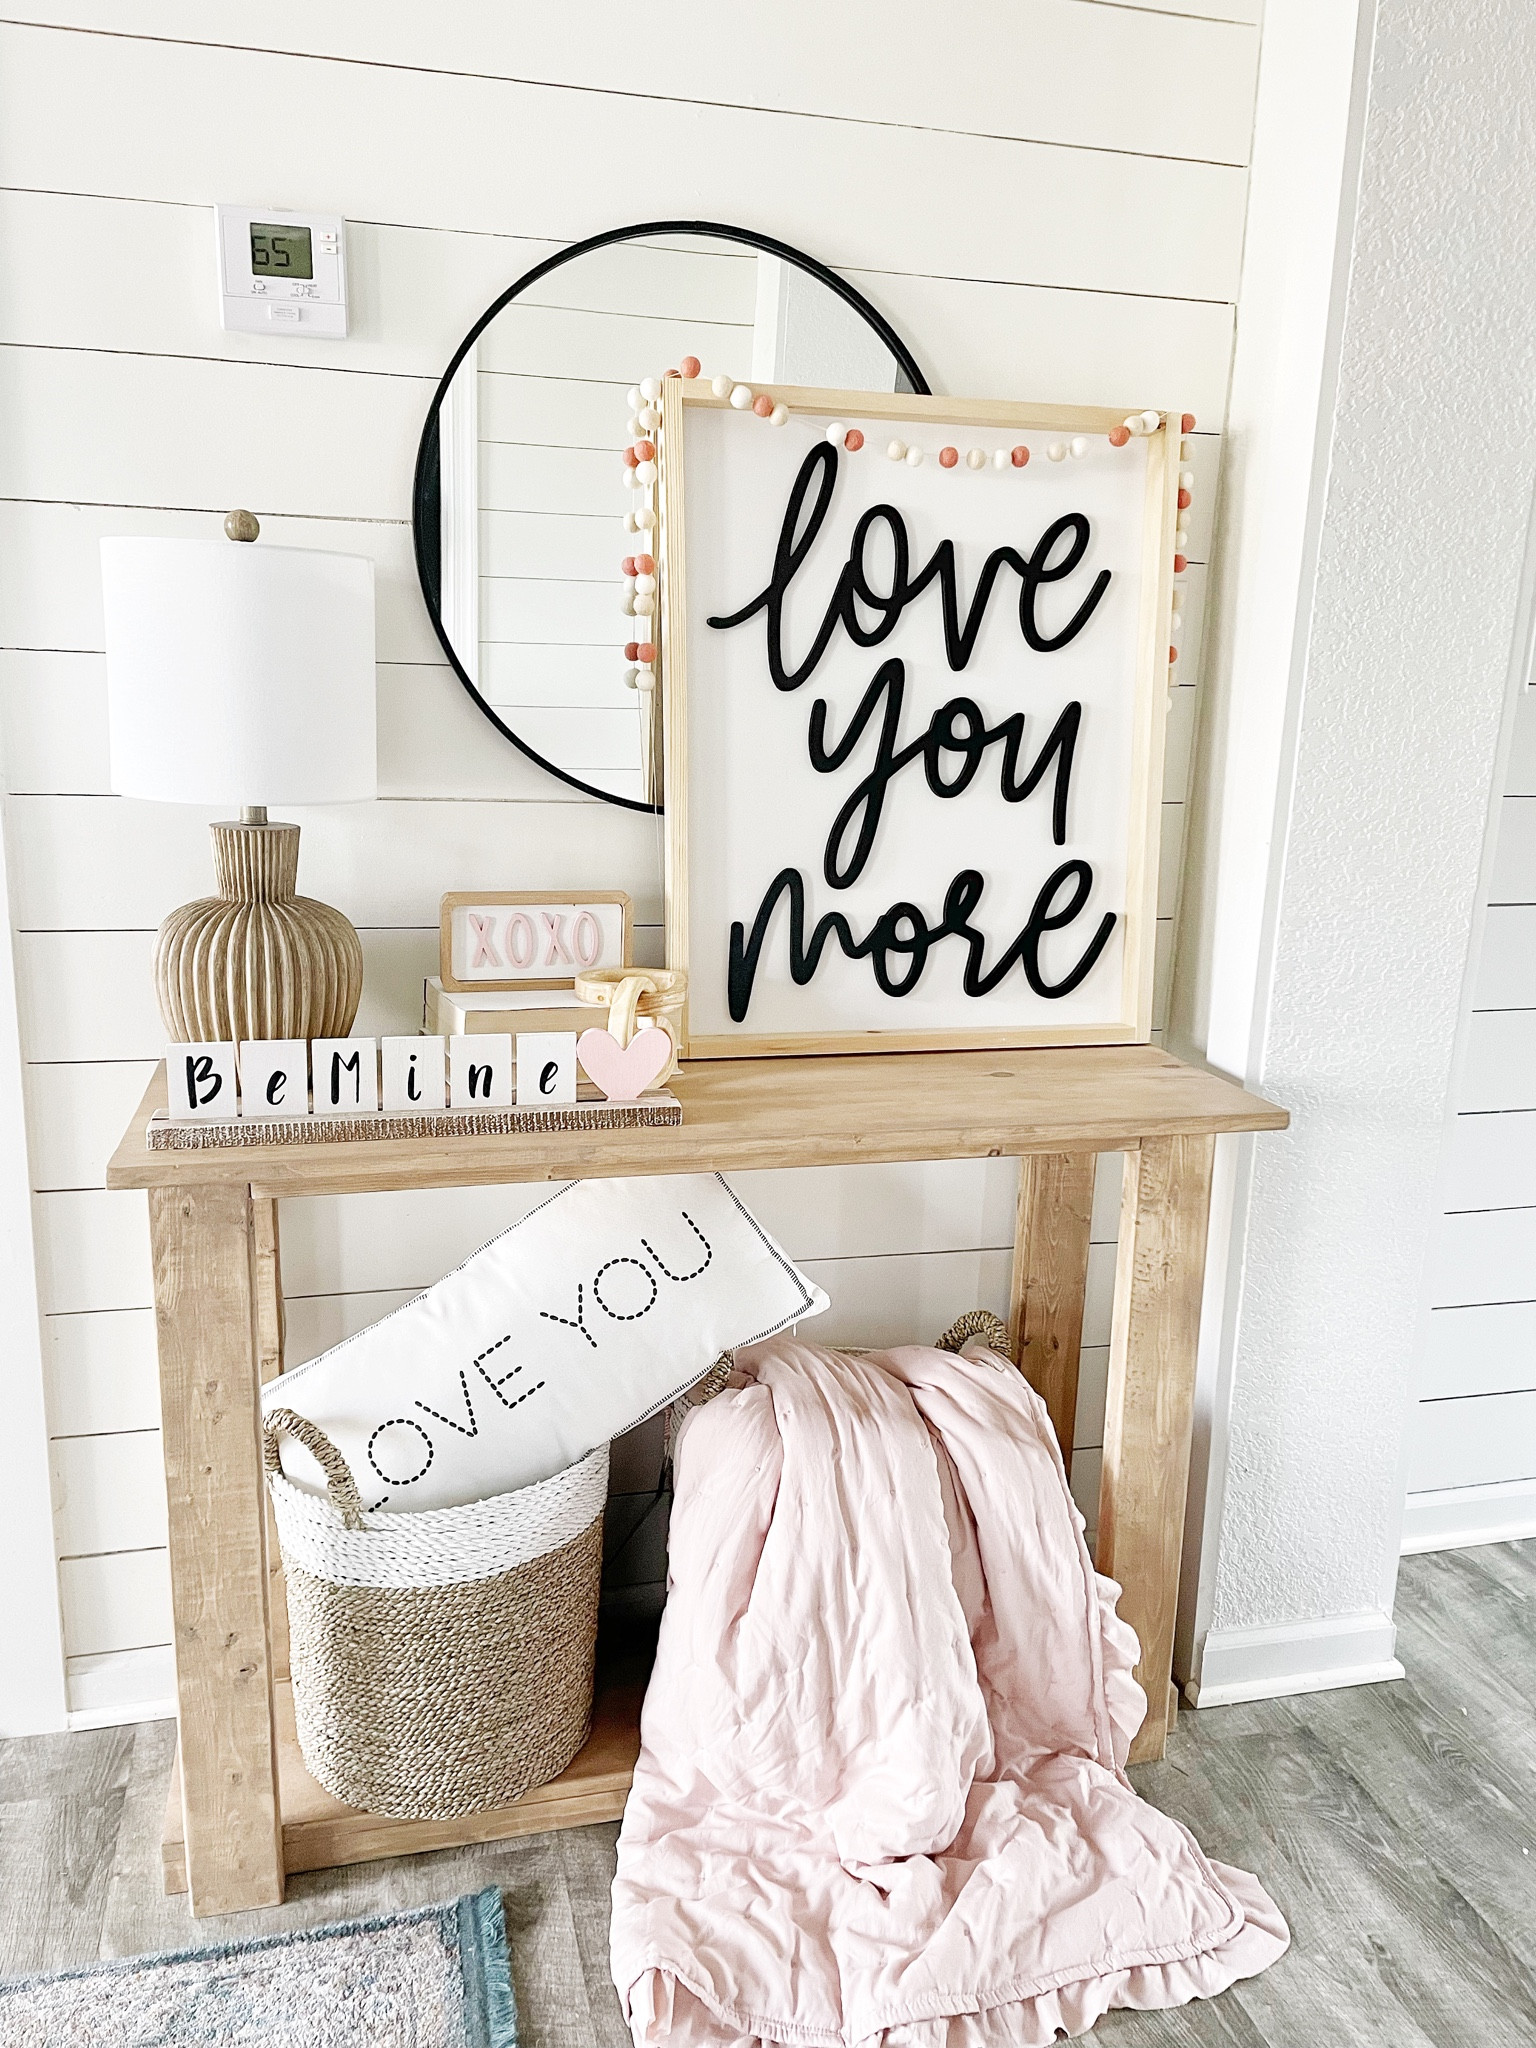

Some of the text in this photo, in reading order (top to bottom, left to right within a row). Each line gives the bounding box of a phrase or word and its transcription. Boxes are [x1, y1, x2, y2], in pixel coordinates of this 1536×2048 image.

[251, 235, 290, 267] 65
[707, 441, 1112, 692] love
[809, 658, 1082, 890] you
[468, 910, 600, 969] XOXO
[728, 860, 1117, 1023] more
[368, 1211, 712, 1513] OVE YOU
